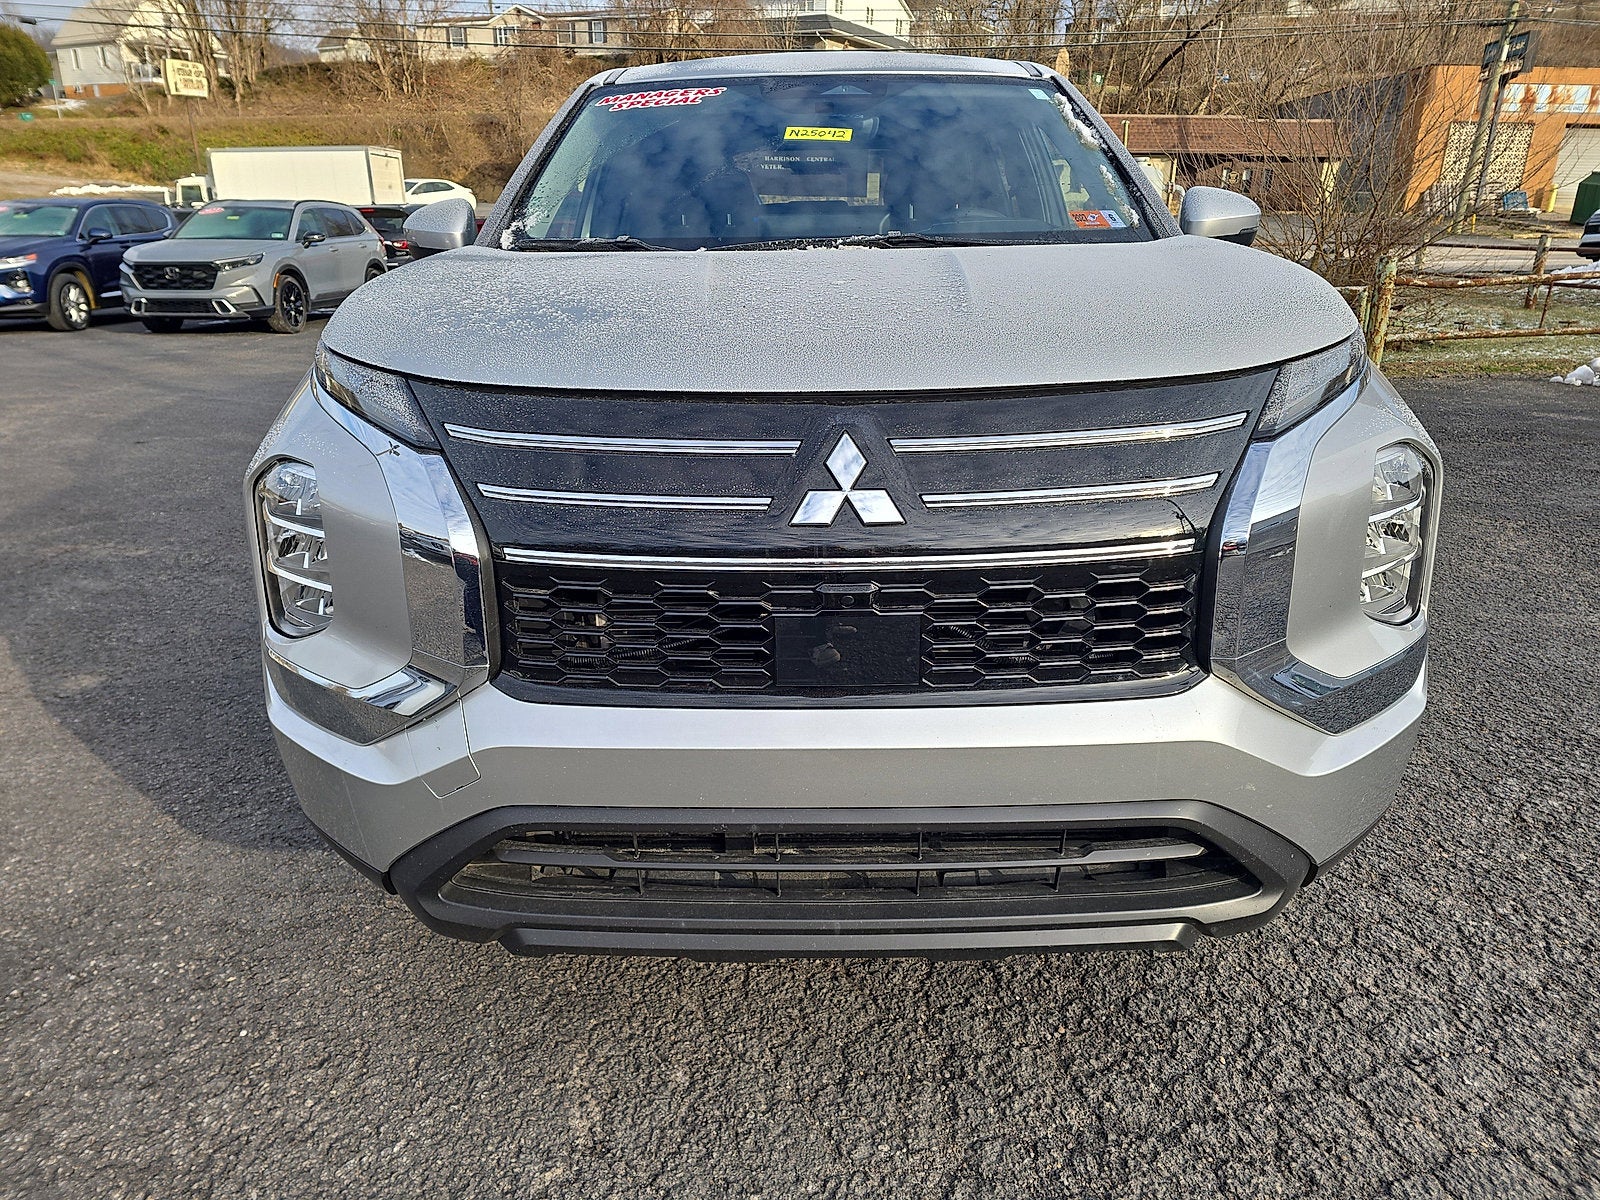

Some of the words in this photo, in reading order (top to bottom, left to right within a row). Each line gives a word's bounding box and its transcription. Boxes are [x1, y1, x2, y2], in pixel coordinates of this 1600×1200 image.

[597, 88, 726, 105] MANAGERS
[611, 96, 700, 110] SPECIAL
[788, 129, 846, 139] N25042
